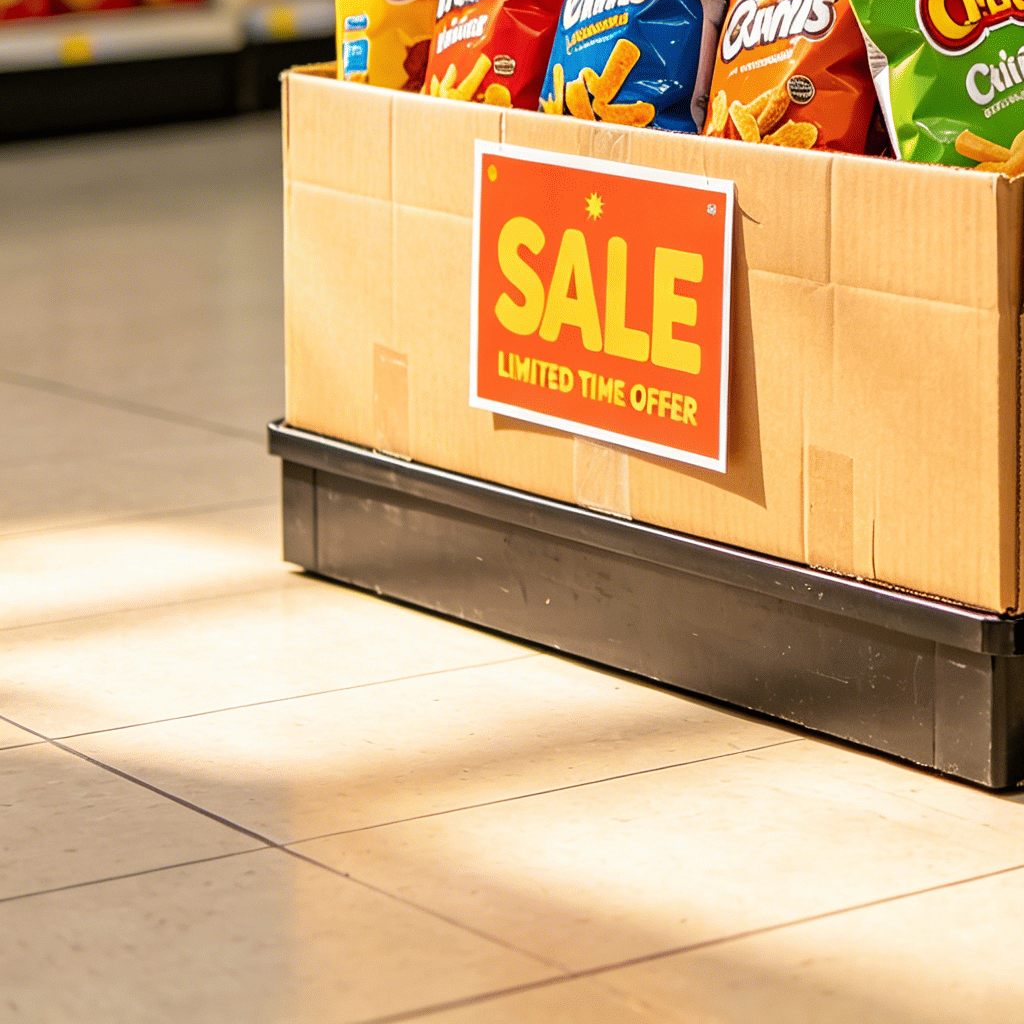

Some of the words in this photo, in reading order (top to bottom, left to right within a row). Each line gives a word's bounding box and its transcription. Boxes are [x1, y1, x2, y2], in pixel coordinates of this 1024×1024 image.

[494, 215, 704, 375] SALE
[497, 350, 574, 394] LIMITED
[578, 369, 626, 408] TIME
[630, 383, 698, 426] OFFER
